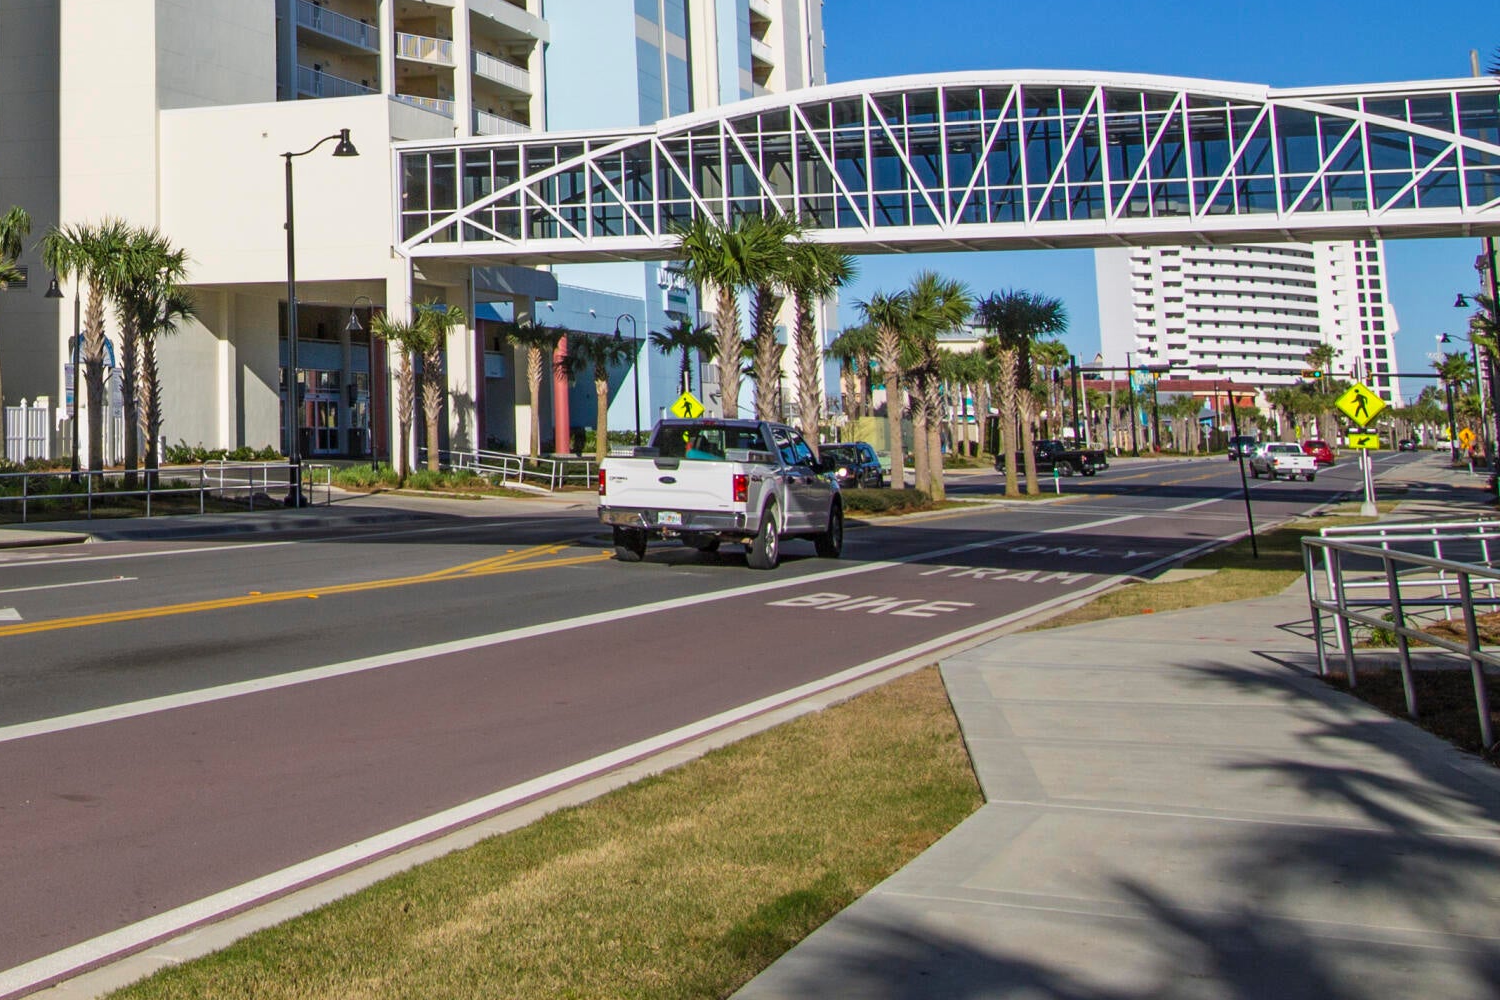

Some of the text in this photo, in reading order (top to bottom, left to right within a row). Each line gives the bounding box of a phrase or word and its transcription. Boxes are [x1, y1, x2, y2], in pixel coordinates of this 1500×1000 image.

[1009, 545, 1155, 559] ONLY
[919, 565, 1093, 585] TRAM
[766, 592, 976, 617] BIKE
